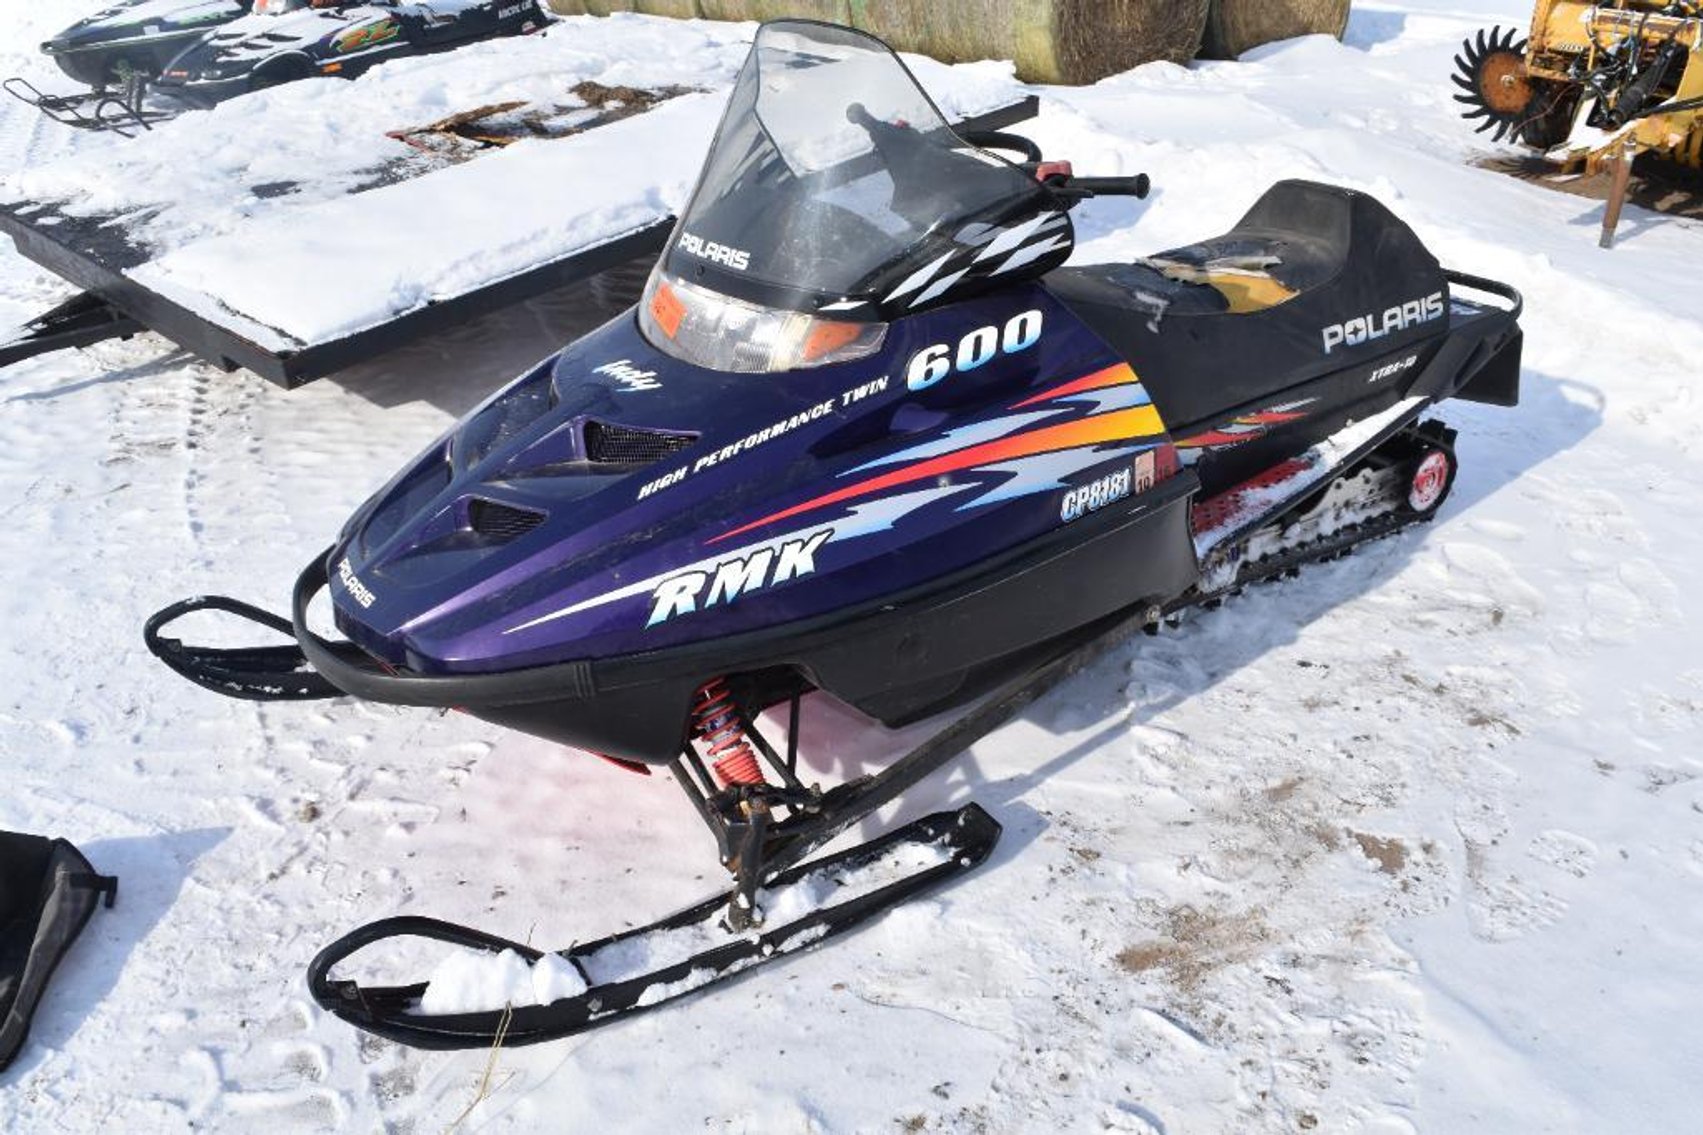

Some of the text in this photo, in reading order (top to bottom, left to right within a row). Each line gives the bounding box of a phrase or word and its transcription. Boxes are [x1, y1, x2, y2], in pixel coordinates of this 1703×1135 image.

[678, 232, 751, 271] POLARIS
[907, 309, 1043, 392] 600
[1322, 291, 1444, 355] POLARIS
[637, 376, 889, 500] HIGH PERFORMANCE TWIN
[338, 557, 376, 608] POLARIS
[645, 527, 835, 629] RMK
